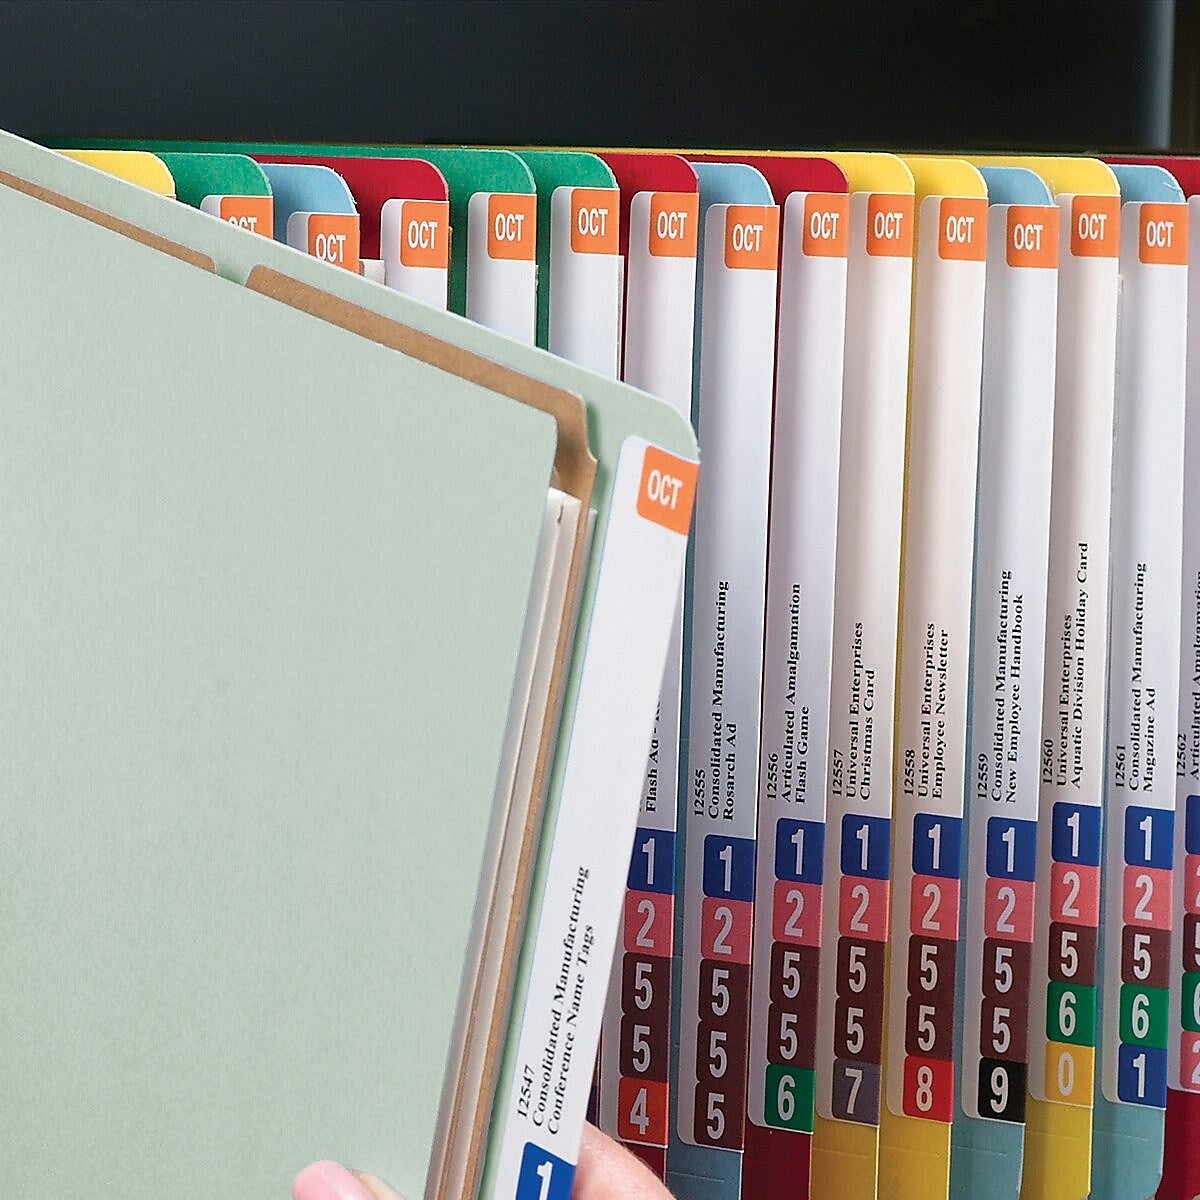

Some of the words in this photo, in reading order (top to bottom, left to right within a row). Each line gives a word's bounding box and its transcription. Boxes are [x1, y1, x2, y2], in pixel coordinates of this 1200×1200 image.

[408, 220, 437, 250] OCT
[495, 213, 523, 242] OCT
[657, 211, 688, 240] OCT
[811, 211, 840, 240] OCT
[946, 216, 975, 243] OCT
[1146, 220, 1174, 247] OCT
[647, 470, 683, 510] OCT
[1077, 543, 1087, 583] Card
[712, 581, 729, 709] Manufacturing
[786, 584, 800, 705] Amalgamation
[995, 571, 1012, 692] Manufacturing
[1010, 595, 1023, 678] Handbook
[1074, 589, 1088, 651] Holiday
[1132, 564, 1146, 683] Manufacturing
[921, 624, 935, 715] Enterprises
[935, 629, 948, 715] Newsletter
[1059, 615, 1074, 705] Enterprises
[1073, 657, 1084, 720] Division
[798, 705, 809, 755] Game
[1007, 684, 1021, 762] Employee
[1145, 688, 1155, 711] Ad
[710, 712, 722, 820] Consolidated
[726, 723, 737, 747] Ad
[781, 708, 795, 802] Articulated
[918, 721, 932, 798] Universal
[932, 721, 946, 800] Employee
[990, 698, 1006, 803] Consolidated
[1043, 739, 1054, 785] 12560
[1057, 711, 1071, 786] Universal
[1071, 724, 1083, 789] Aquatic
[1115, 745, 1127, 788] 12561
[1129, 689, 1141, 791] Consolidated
[1143, 716, 1156, 792] Magazine
[693, 768, 705, 817] 12555
[723, 752, 736, 821] Rosarch
[766, 753, 778, 800] 12556
[795, 760, 806, 804] Flash
[904, 749, 916, 796] 12558
[978, 753, 987, 799] 12559
[1005, 768, 1016, 803] New
[533, 1009, 564, 1126] Consolidated
[554, 866, 590, 1004] Manufacturing
[545, 1030, 574, 1134] Conference
[567, 974, 584, 1027] Name
[576, 925, 594, 966] Tags
[517, 1065, 537, 1117] 12547
